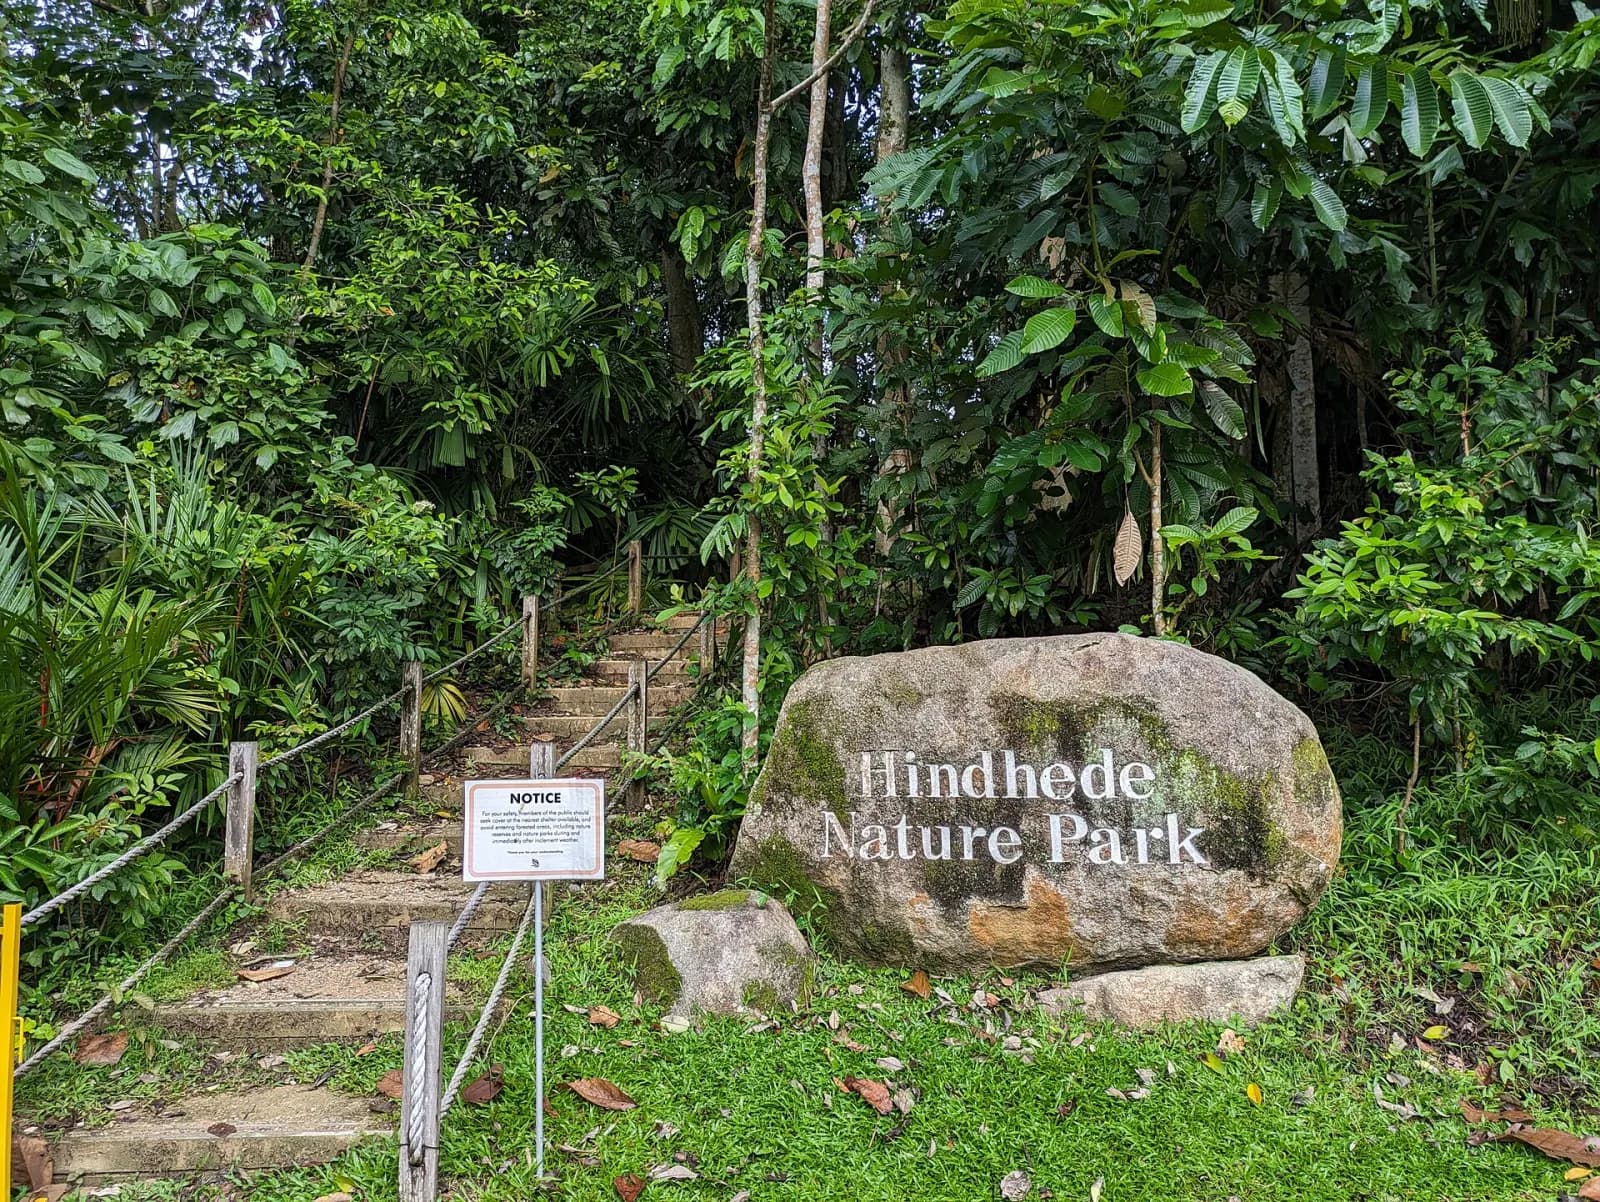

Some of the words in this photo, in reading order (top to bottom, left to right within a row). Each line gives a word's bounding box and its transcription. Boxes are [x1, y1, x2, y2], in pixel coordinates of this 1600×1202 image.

[510, 792, 561, 804] NOTICE
[861, 749, 1156, 800] Hindhede
[821, 811, 1023, 864] Nature
[1046, 812, 1210, 865] Park
